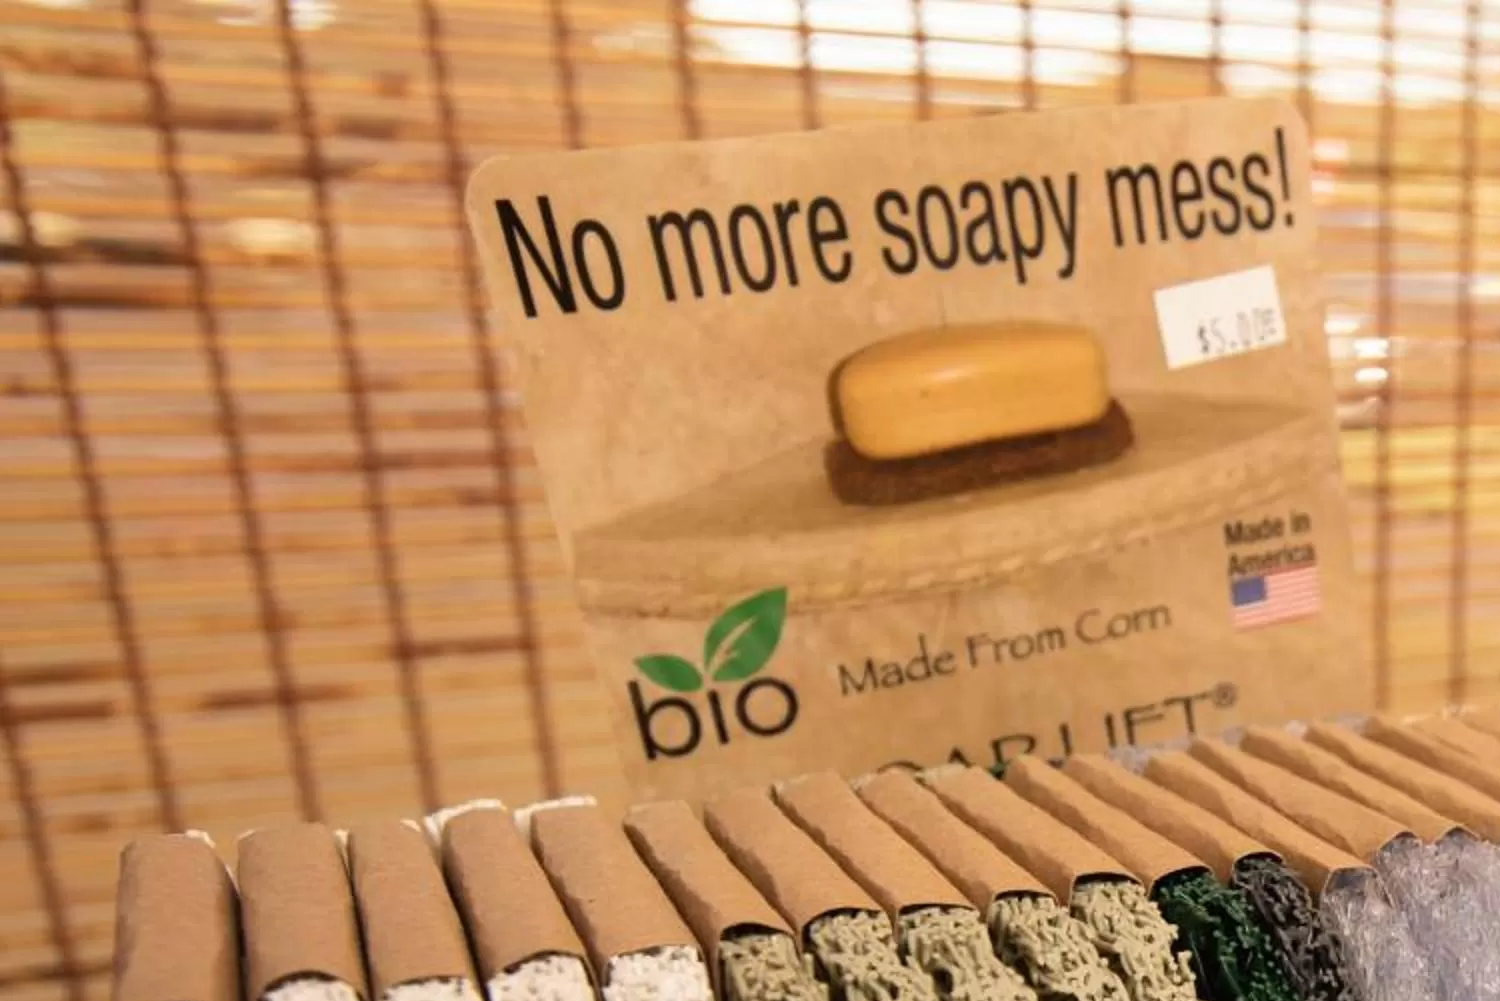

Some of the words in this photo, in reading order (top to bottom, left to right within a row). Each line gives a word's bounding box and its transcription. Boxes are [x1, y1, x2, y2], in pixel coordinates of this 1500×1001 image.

[494, 194, 626, 320] No
[646, 194, 854, 304] more
[873, 173, 1080, 285] soapy
[1103, 126, 1296, 249] mess!
[1223, 515, 1286, 547] Made
[1289, 508, 1312, 536] in
[1227, 543, 1316, 577] America
[837, 632, 957, 697] Made
[965, 624, 1067, 670] From
[1074, 604, 1173, 646] Corn
[628, 676, 799, 762] bio
